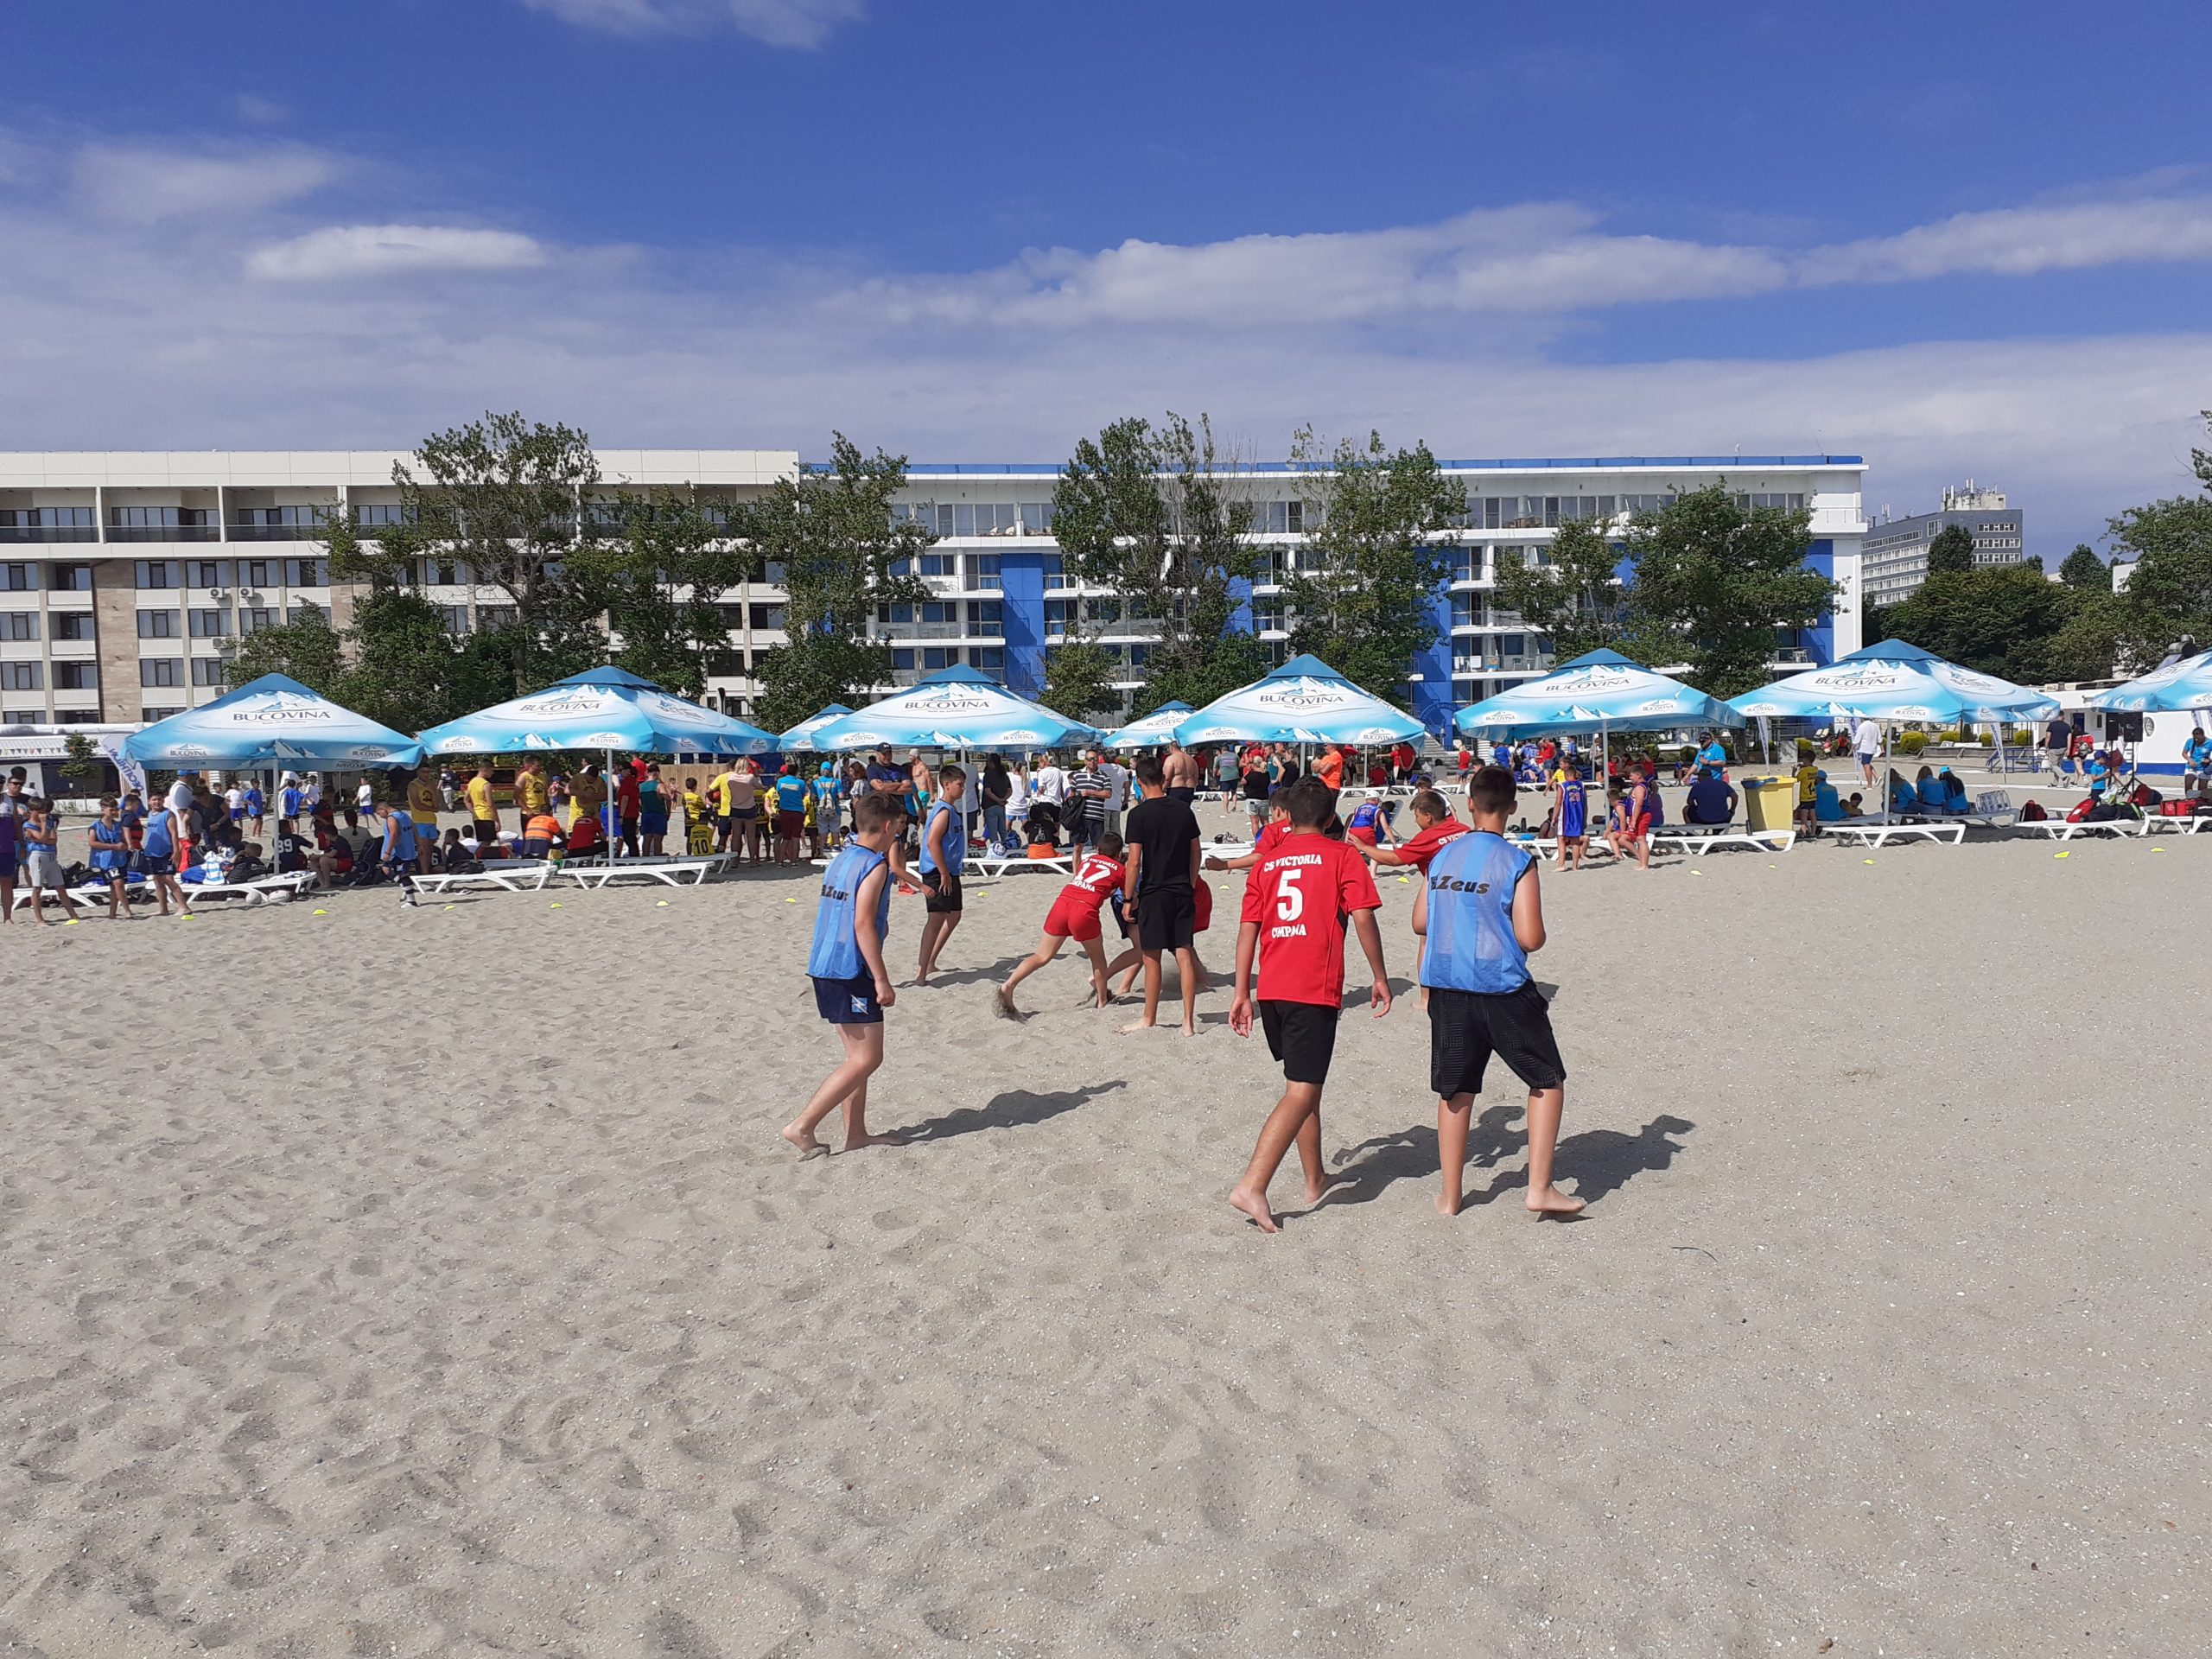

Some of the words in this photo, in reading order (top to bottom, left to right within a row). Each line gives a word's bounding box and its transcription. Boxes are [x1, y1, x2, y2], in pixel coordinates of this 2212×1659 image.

[1546, 679, 1630, 692] BUCOVINA
[1815, 677, 1897, 686] BUCOVINA
[905, 701, 989, 709] BUCOVINA
[1260, 695, 1343, 704] BUCOVINA
[519, 702, 603, 712] BUCOVINA
[232, 710, 331, 722] BUCOVINA
[694, 839, 709, 855] 10
[1264, 861, 1275, 873] CS
[1275, 854, 1322, 868] VICTORIA
[1074, 862, 1111, 884] 17
[1436, 875, 1491, 893] Zeus
[1276, 868, 1303, 922] 5
